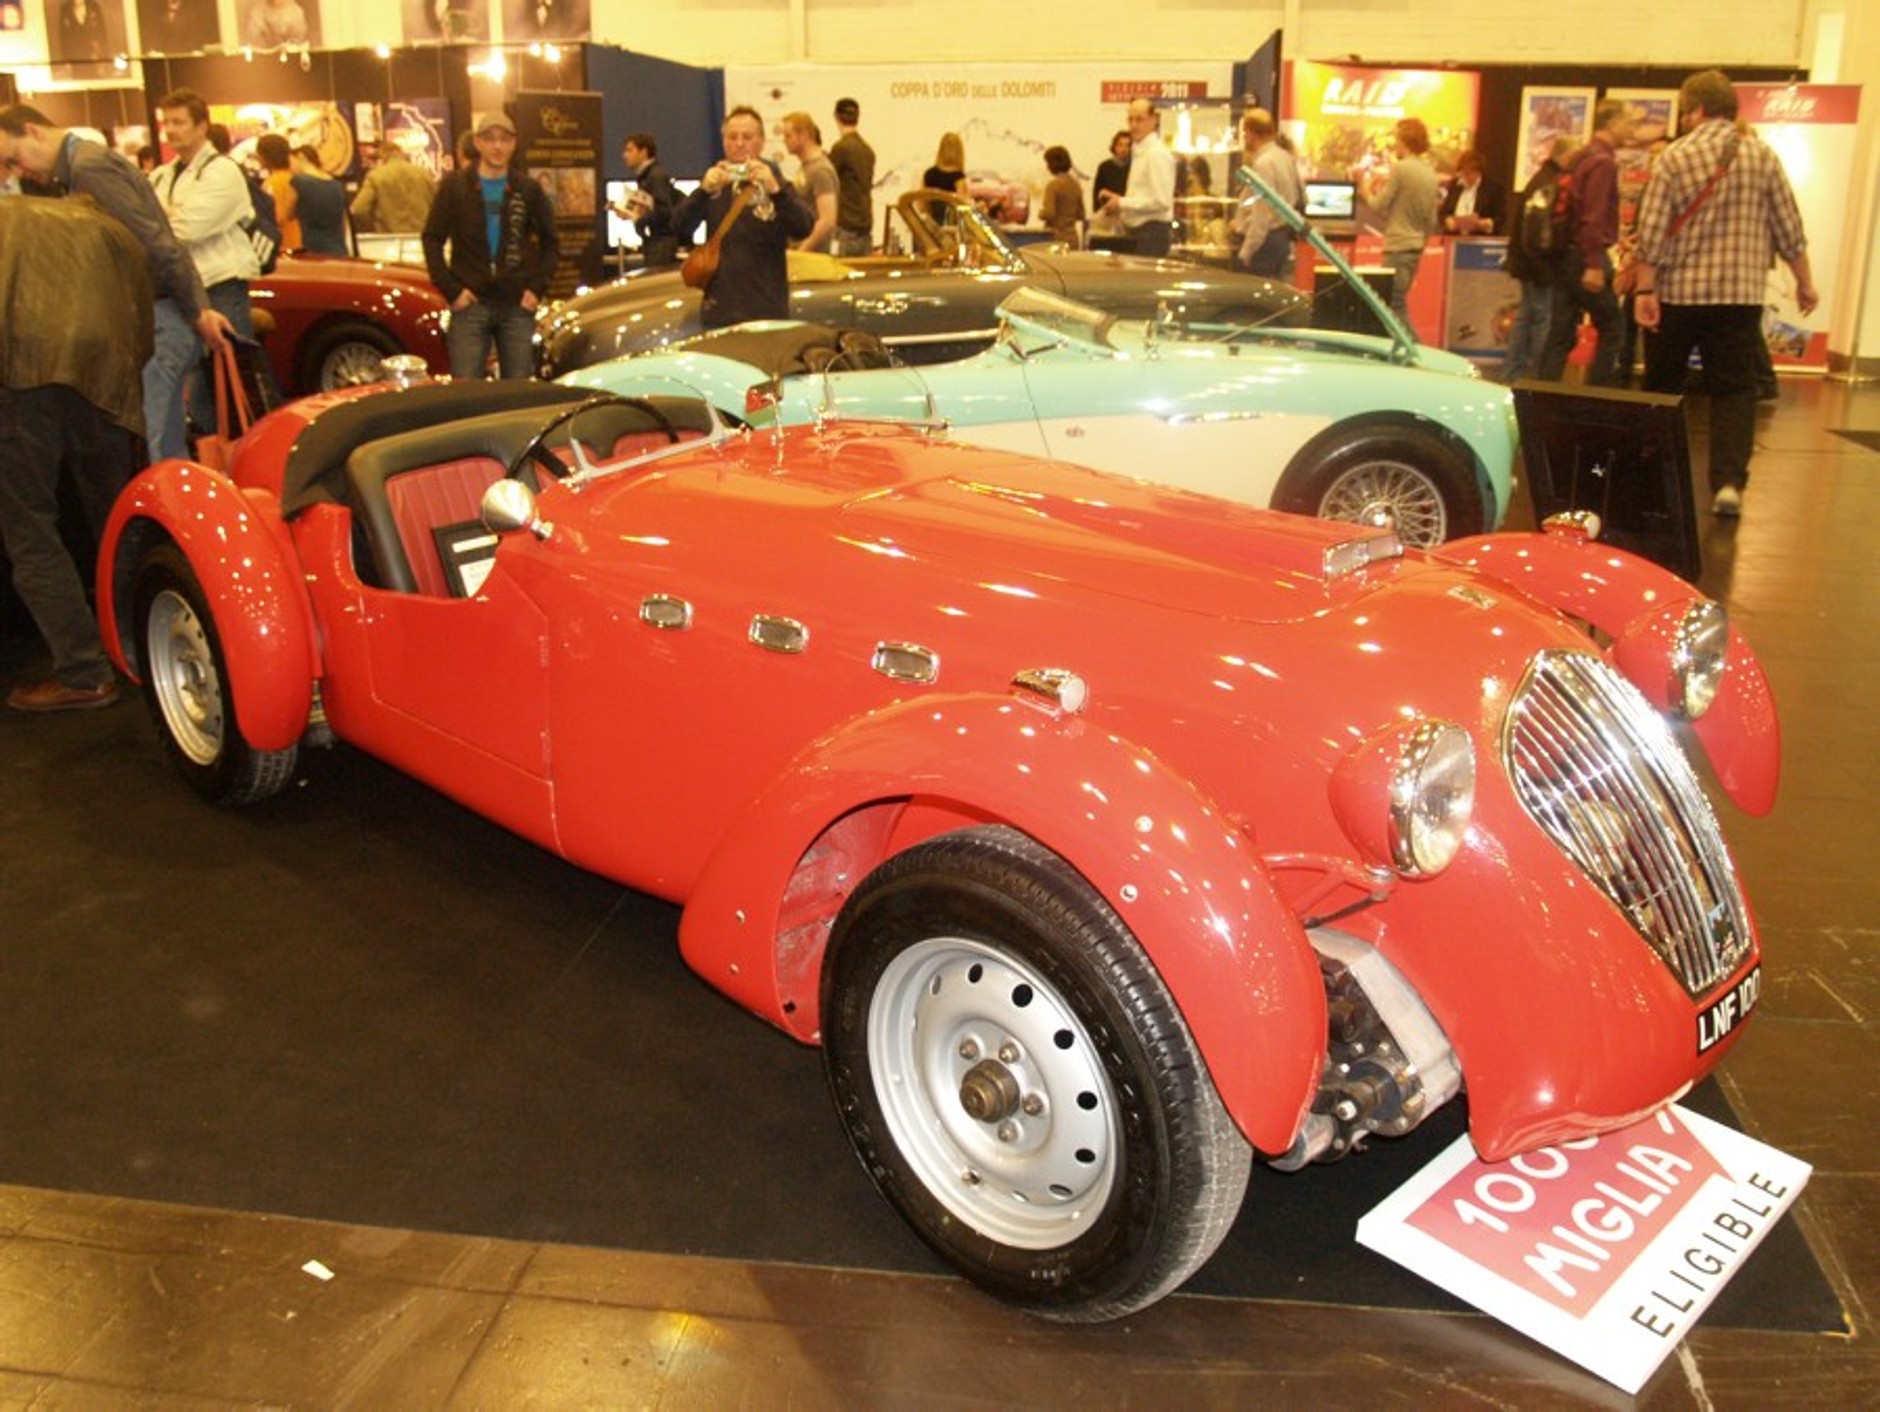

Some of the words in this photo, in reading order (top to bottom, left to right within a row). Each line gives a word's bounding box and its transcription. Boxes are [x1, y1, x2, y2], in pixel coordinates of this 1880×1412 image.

[890, 82, 929, 98] COPPA
[932, 81, 968, 98] D'ORO
[1001, 81, 1057, 98] DOLOMITI
[1160, 82, 1189, 98] 2011
[1322, 78, 1407, 104] RAID
[1698, 991, 1737, 1052] LNF
[1738, 967, 1761, 1018] 100
[1453, 1136, 1600, 1232] 100
[1523, 1144, 1694, 1298] MIGLIA
[1629, 1172, 1788, 1338] ELIGIBLE
